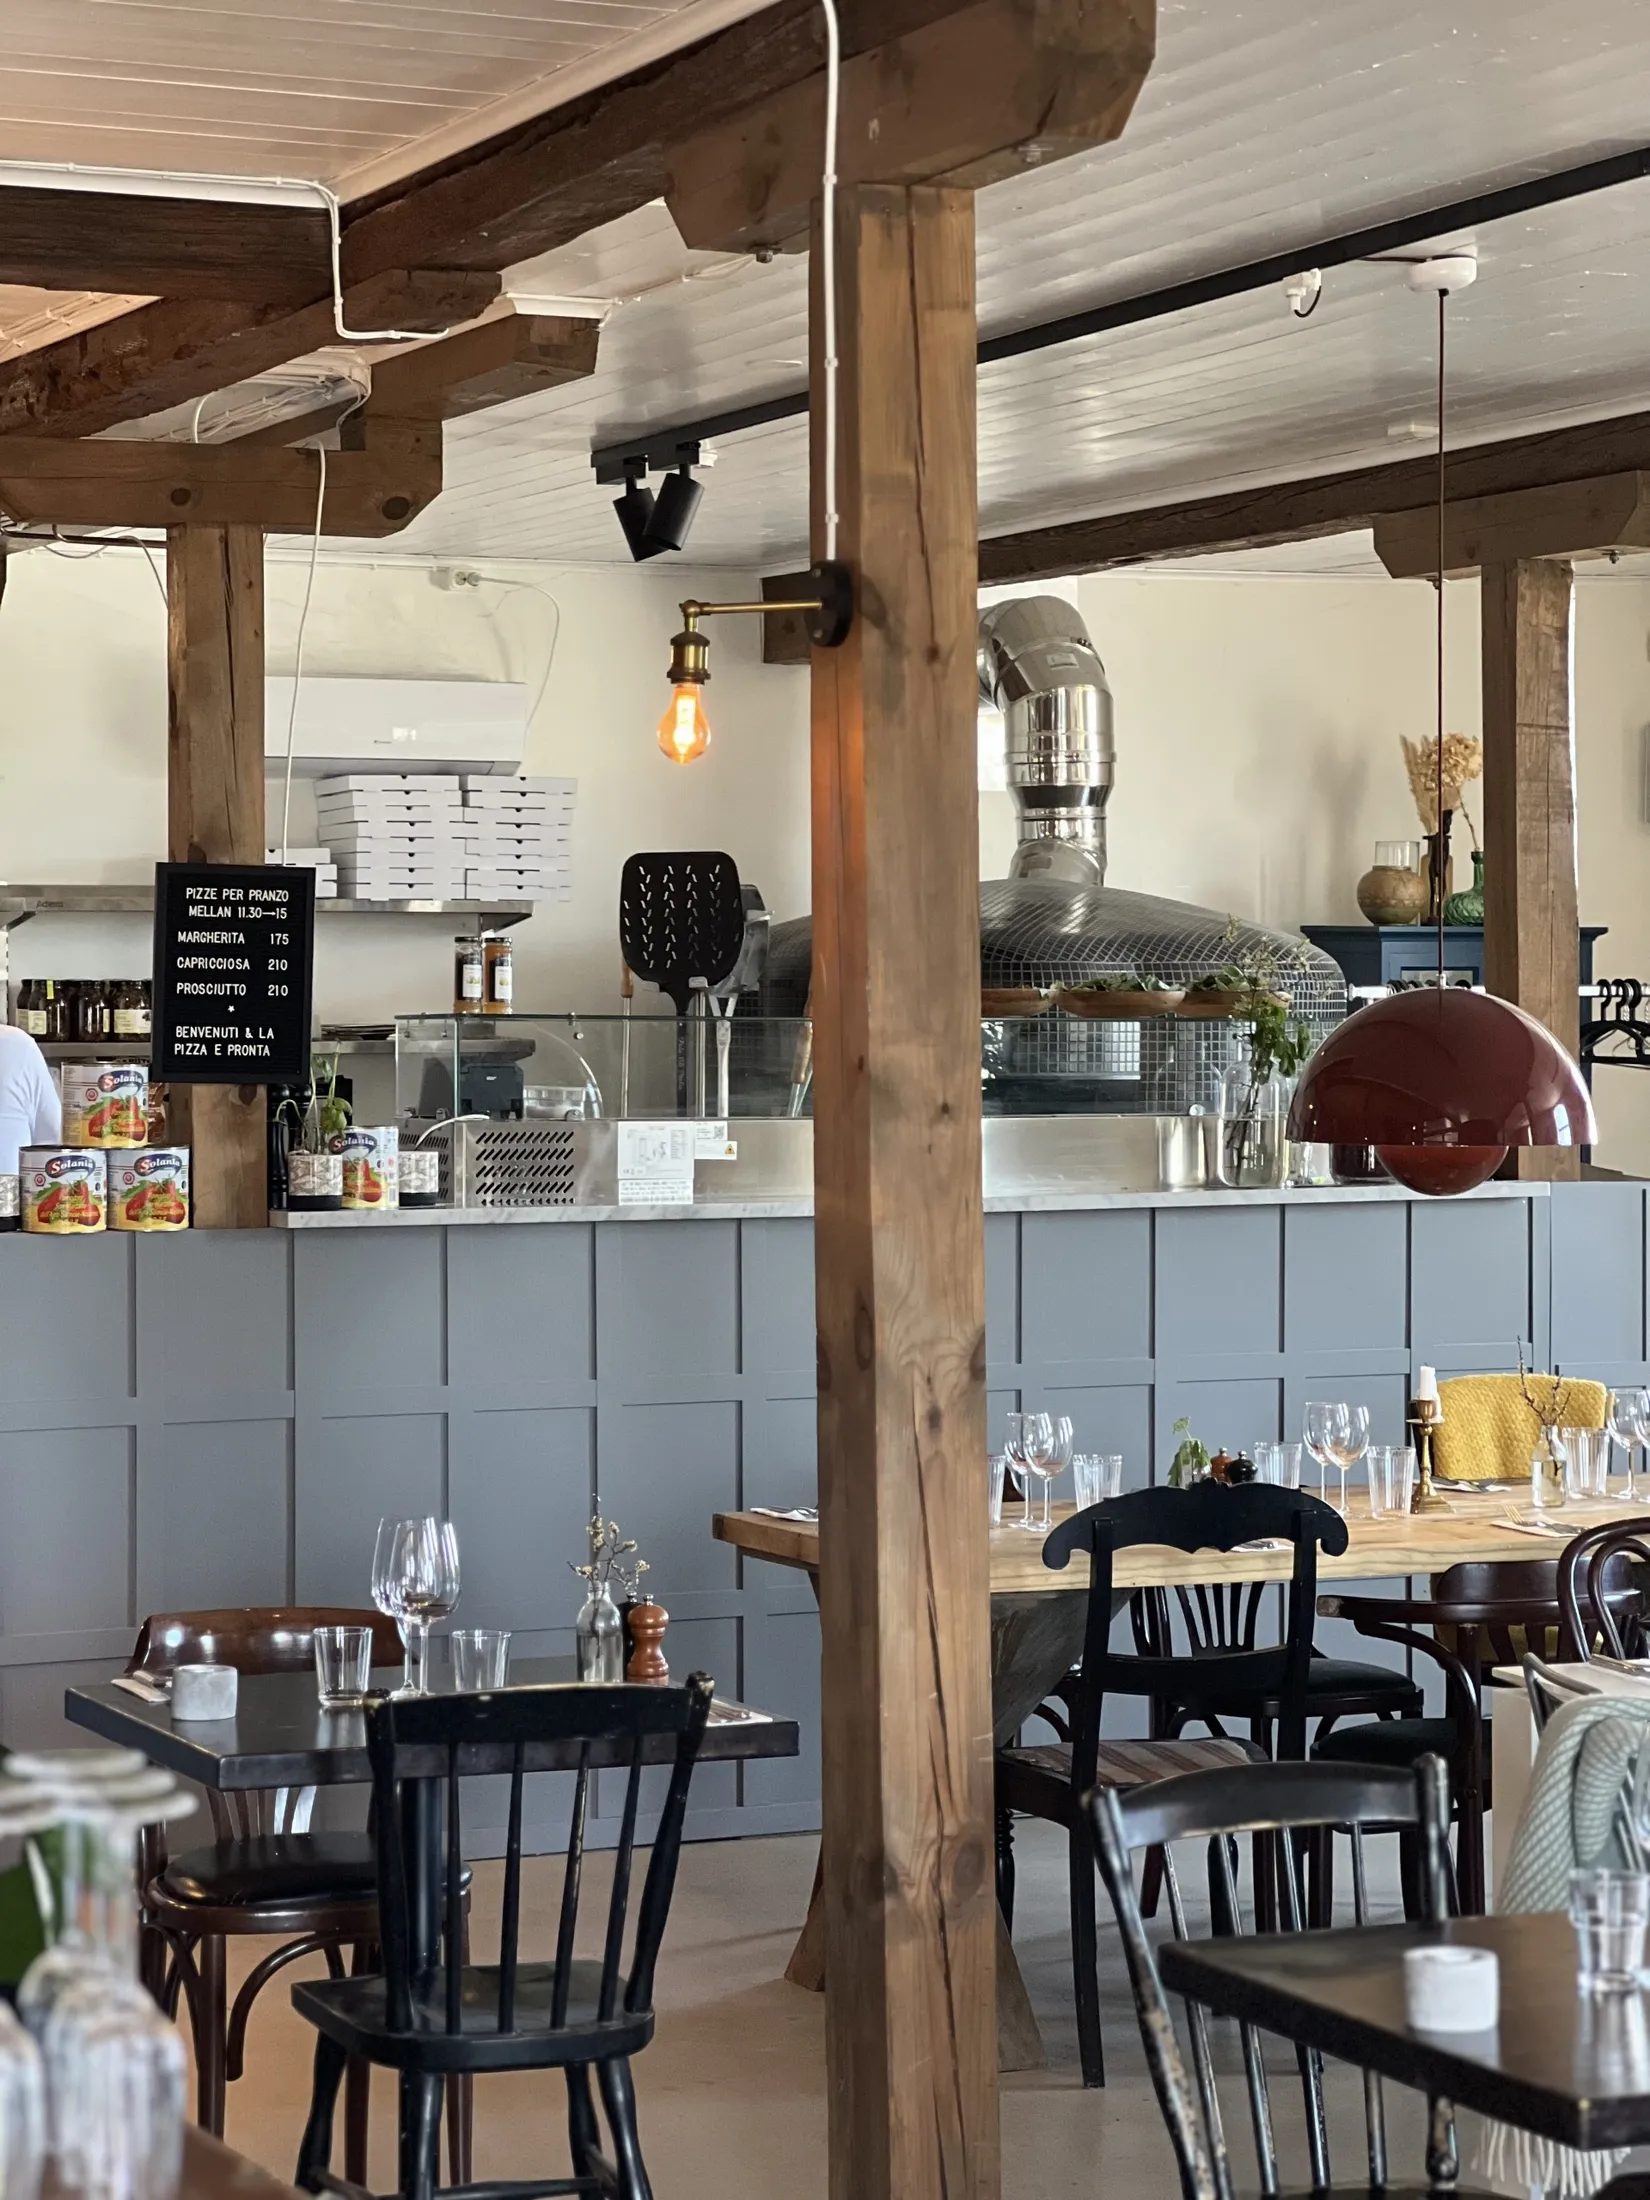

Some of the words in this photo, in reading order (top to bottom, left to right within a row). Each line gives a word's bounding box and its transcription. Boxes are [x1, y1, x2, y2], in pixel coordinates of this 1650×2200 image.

[185, 887, 218, 900] PIZZE
[222, 888, 244, 901] PER
[249, 889, 289, 902] PRANZO
[188, 905, 232, 918] MELLAN
[177, 931, 245, 945] MARGHERITA
[270, 933, 289, 946] 175
[176, 957, 251, 970] CAPRICCIOSA
[267, 959, 288, 971] 210
[176, 982, 247, 997] PROSCIUTTO
[267, 984, 289, 997] 210
[175, 1025, 239, 1039] BENVENUTI
[245, 1027, 254, 1039] &
[258, 1026, 275, 1040] LA
[174, 1043, 208, 1056] PIZZA
[214, 1044, 222, 1056] E
[227, 1044, 271, 1057] PRONTA
[333, 1136, 375, 1151] Solania
[51, 1159, 94, 1175] Solania
[140, 1158, 181, 1173] Solania
